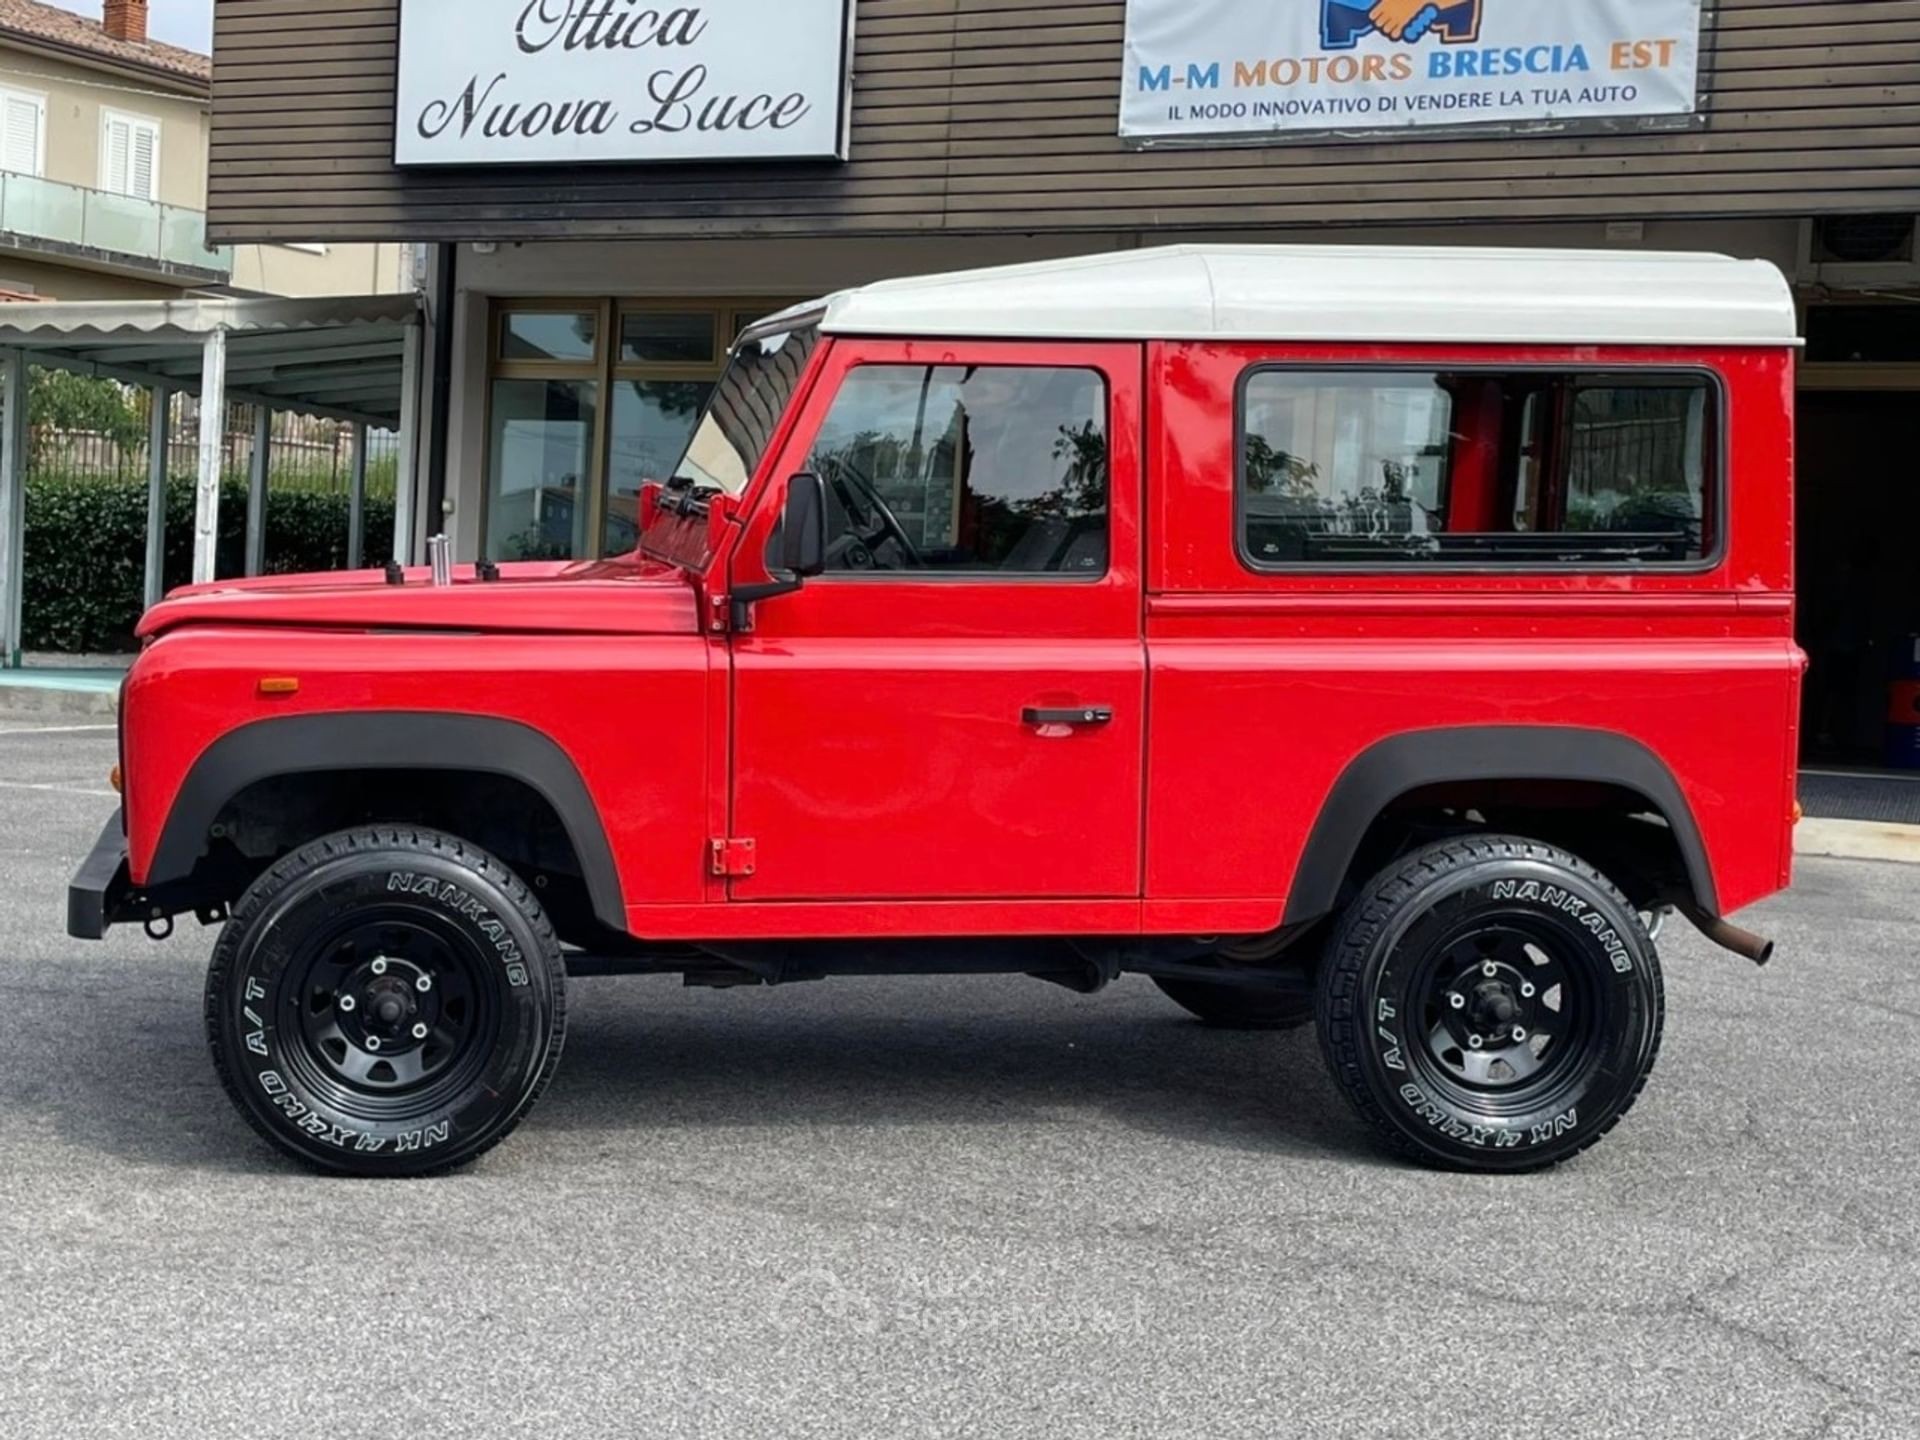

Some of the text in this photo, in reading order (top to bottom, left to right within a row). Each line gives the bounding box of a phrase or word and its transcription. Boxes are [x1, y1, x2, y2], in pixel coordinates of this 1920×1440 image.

[515, 0, 708, 54] Ottica
[1138, 39, 1677, 92] M-M MOTORS BRESCIA EST
[416, 63, 813, 140] Nuova Luce
[1168, 85, 1638, 120] IL MODO INNOVATIVO DI VENDERE LA TUA AUTO
[386, 871, 529, 987] NANKANG
[1493, 880, 1632, 974] NANKANG
[244, 976, 269, 1057] A/T
[1378, 998, 1407, 1071] A/T
[394, 1120, 449, 1153] NK
[1531, 1108, 1578, 1146] NK
